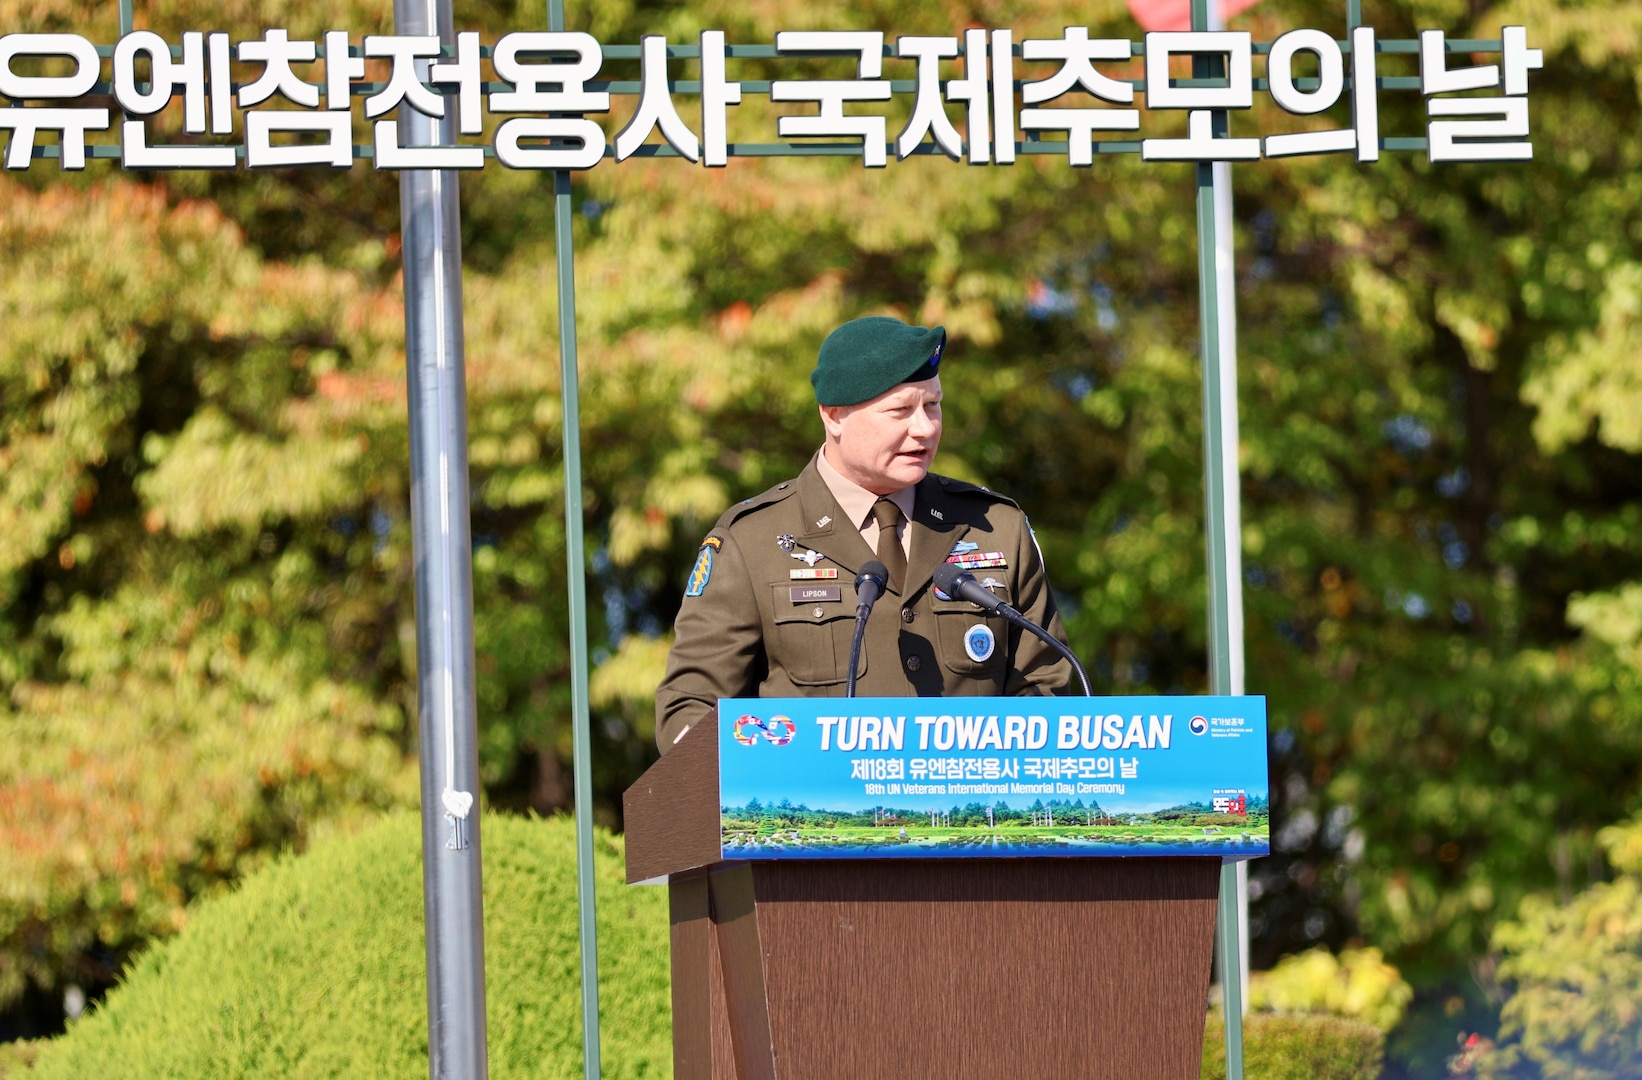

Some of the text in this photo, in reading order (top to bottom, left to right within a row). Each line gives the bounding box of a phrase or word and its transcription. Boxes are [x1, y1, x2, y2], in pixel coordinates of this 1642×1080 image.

[0, 25, 1544, 170] 유엔참전용사 국제추모의 날
[802, 590, 827, 598] LIPSON
[1210, 717, 1245, 726] 국가보훈부
[816, 714, 1174, 751] TURN TOWARD BUSAN
[851, 757, 1139, 780] 제18회 유엔참전용사 국제추모의 날
[865, 782, 1125, 796] 18th UN Veterans International Memorial Day Ceremony
